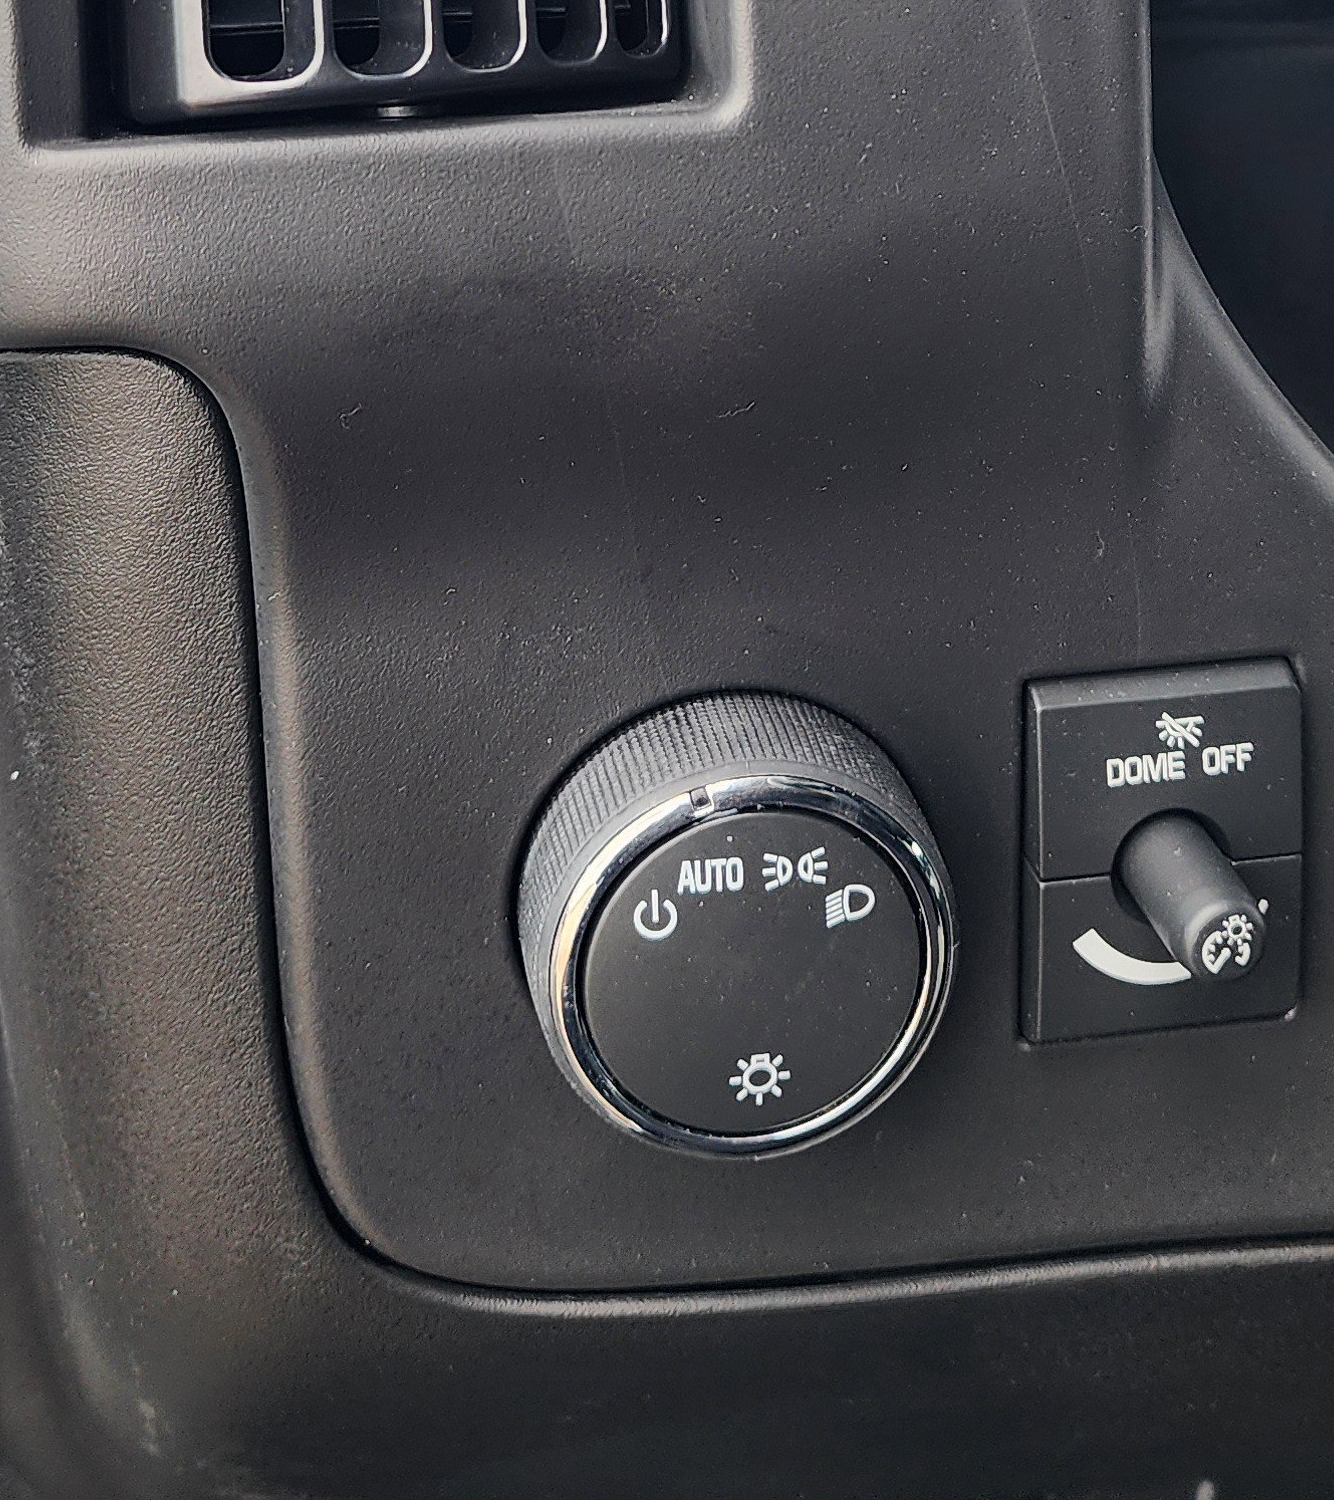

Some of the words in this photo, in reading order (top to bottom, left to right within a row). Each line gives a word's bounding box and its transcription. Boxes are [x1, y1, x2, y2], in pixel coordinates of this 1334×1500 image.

[1106, 750, 1186, 789] DOME
[1201, 742, 1254, 776] OFF
[677, 856, 744, 896] AUTO
